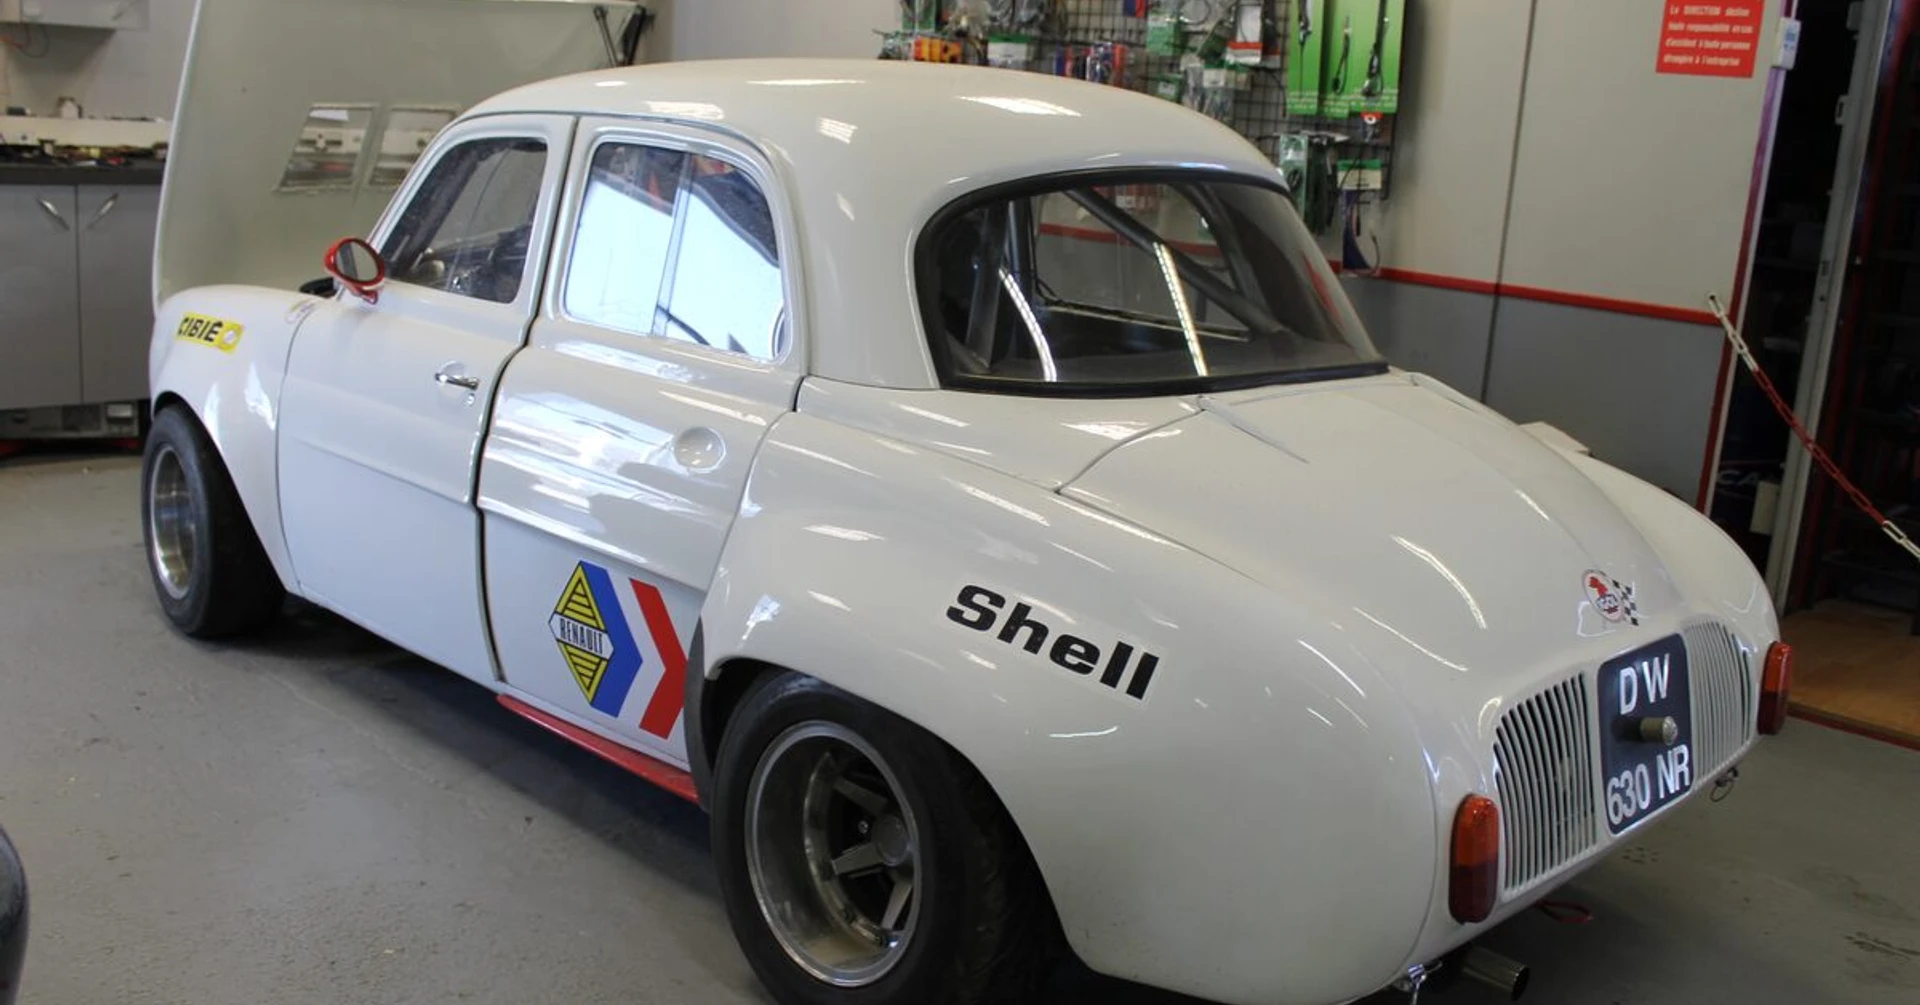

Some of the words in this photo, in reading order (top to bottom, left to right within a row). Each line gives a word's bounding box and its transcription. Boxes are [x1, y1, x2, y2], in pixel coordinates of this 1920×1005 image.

[559, 617, 603, 655] RENAULT
[946, 584, 1159, 700] Shell
[1607, 763, 1651, 826] 630
[1655, 744, 1691, 799] NR
